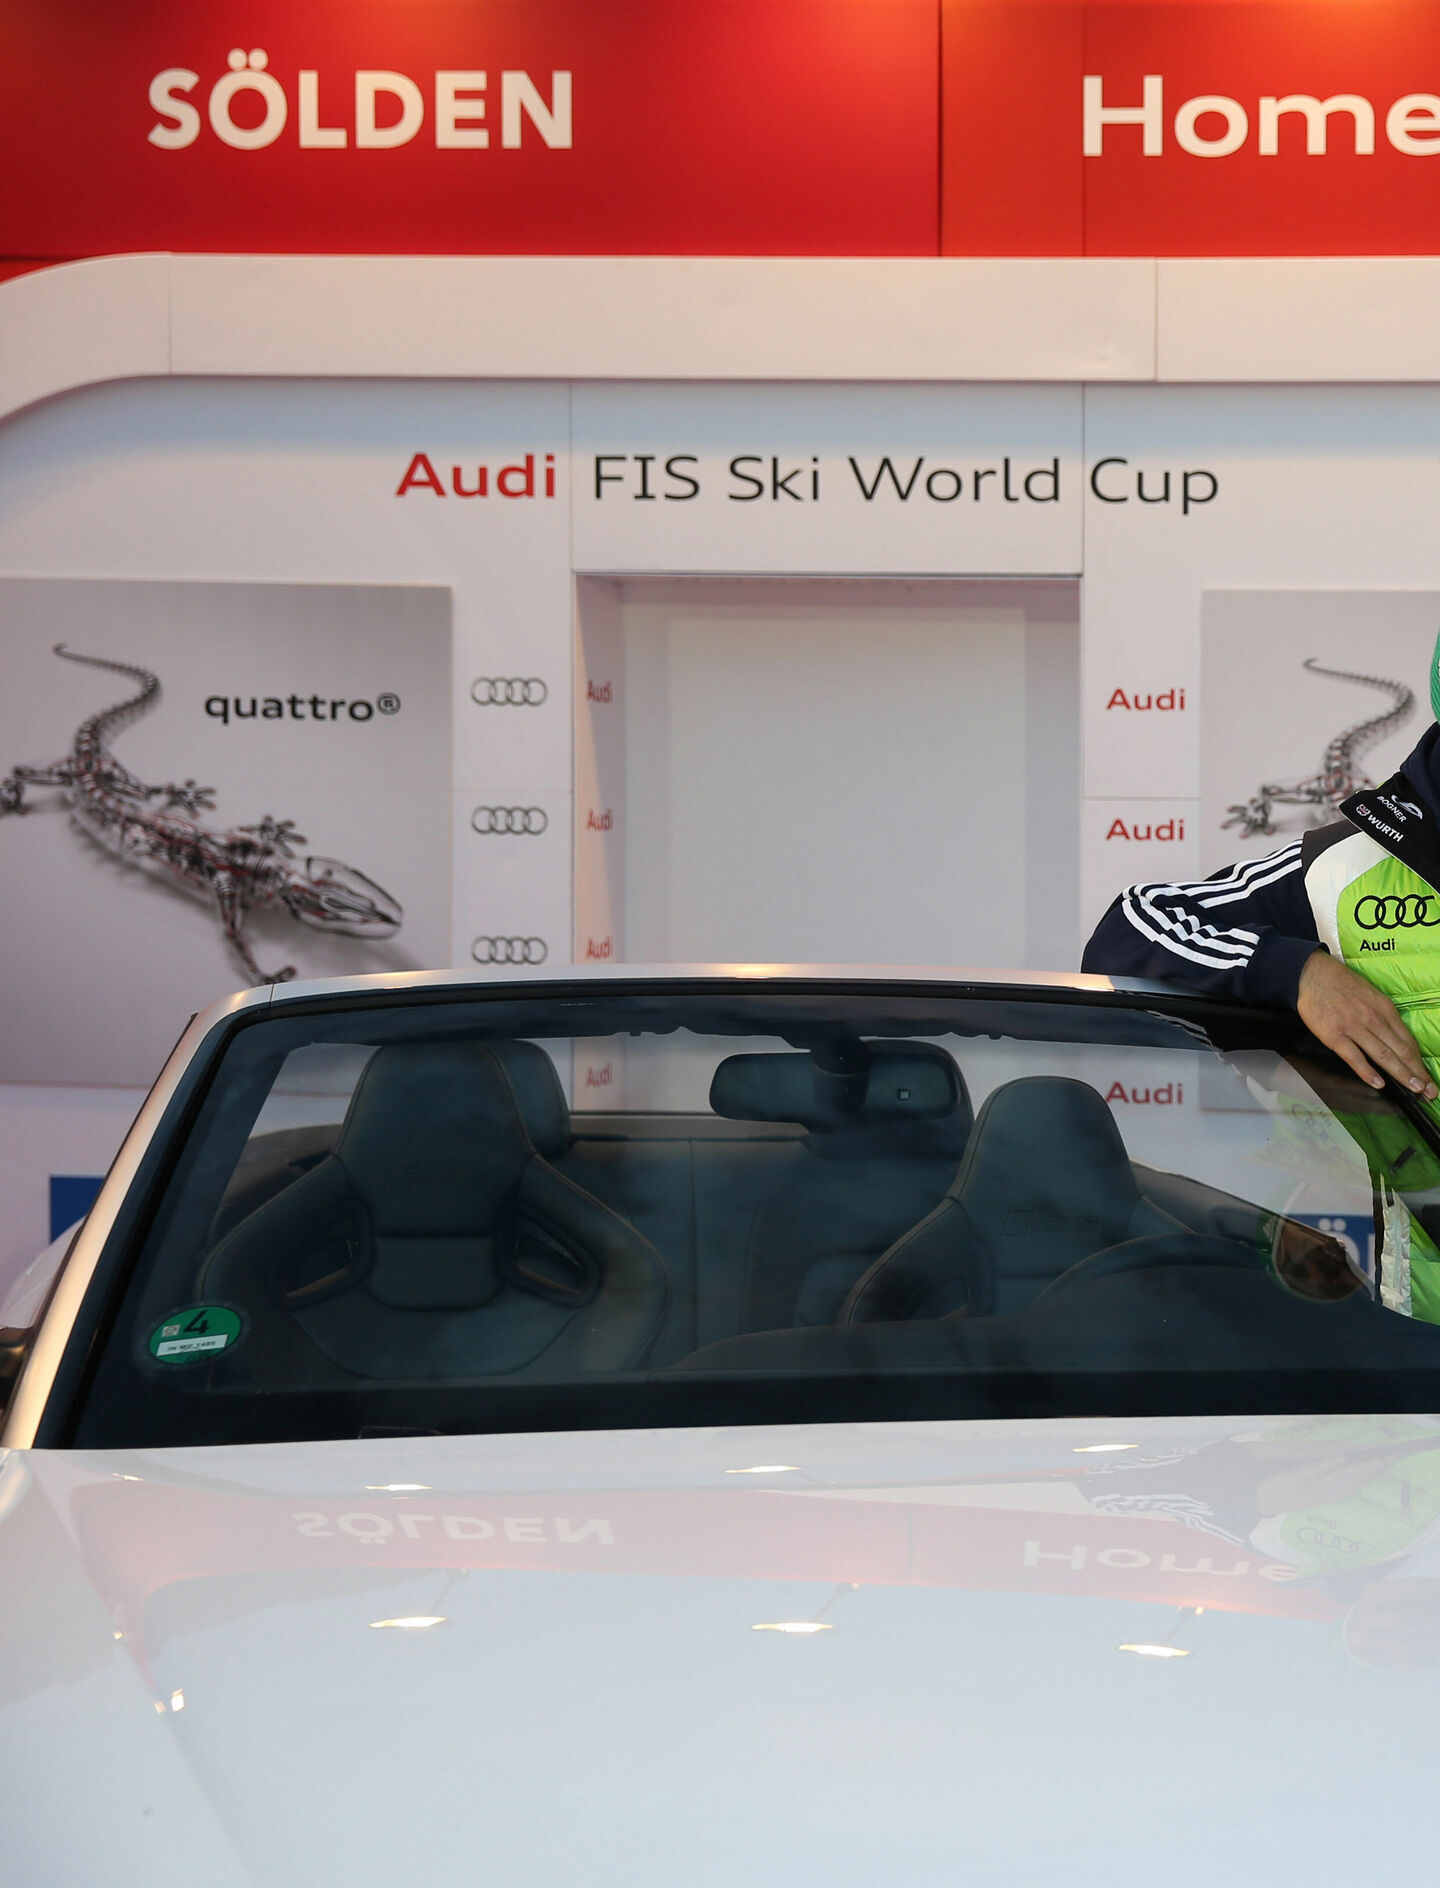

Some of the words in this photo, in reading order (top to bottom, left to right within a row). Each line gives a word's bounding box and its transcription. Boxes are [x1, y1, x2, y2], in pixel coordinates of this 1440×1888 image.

[148, 48, 574, 150] SÖLDEN
[396, 453, 556, 498] Audi
[594, 455, 701, 501] FIS
[728, 456, 820, 501] Ski
[848, 457, 1060, 502] World
[1090, 457, 1219, 515] Cup
[1106, 688, 1186, 711] Audi
[1106, 818, 1186, 841] Audi
[1359, 938, 1396, 952] Audi
[1106, 1081, 1184, 1105] Audi
[184, 1309, 209, 1335] 4
